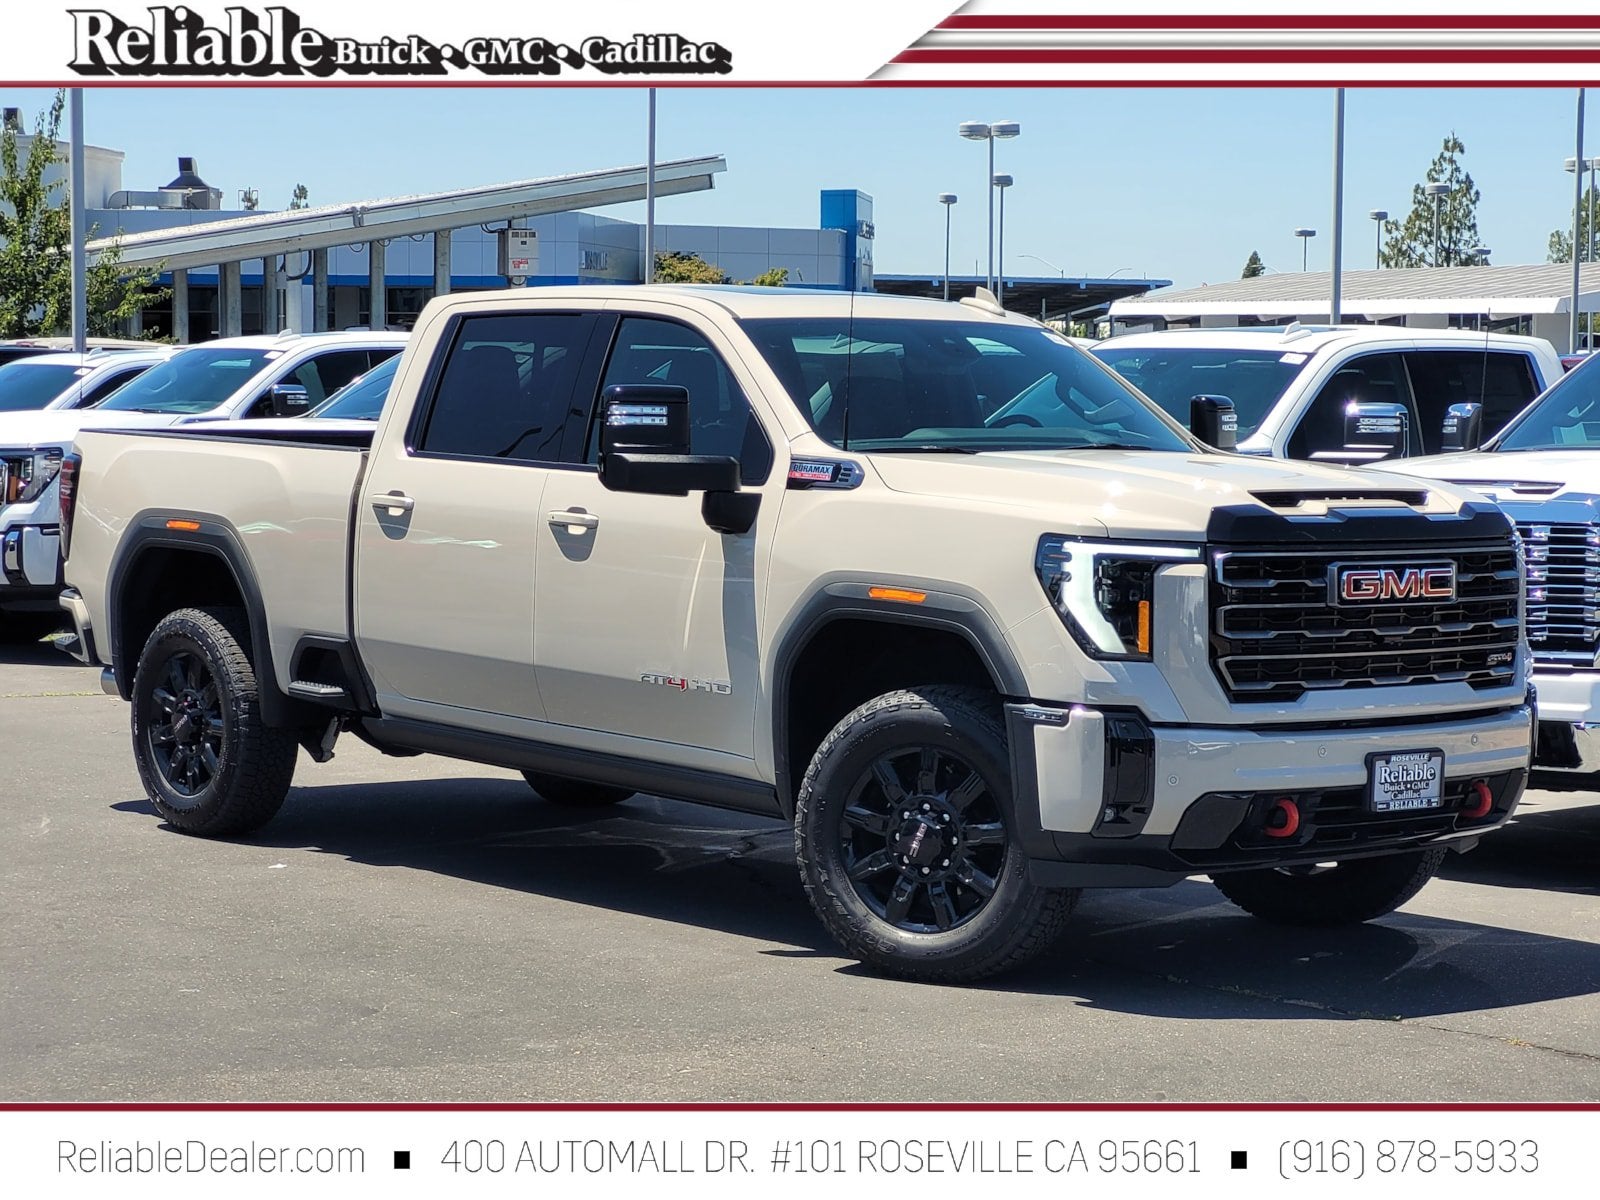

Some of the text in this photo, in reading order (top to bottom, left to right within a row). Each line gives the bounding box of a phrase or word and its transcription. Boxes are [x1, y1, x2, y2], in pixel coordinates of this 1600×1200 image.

[793, 463, 832, 474] DURAMAX
[1342, 568, 1453, 600] GMC
[1391, 753, 1430, 762] ROSEVILLE
[1379, 763, 1436, 784] Reliable
[1384, 781, 1430, 792] Buick GMC
[1391, 790, 1421, 800] Cadillac
[1389, 800, 1428, 810] RELIABLE
